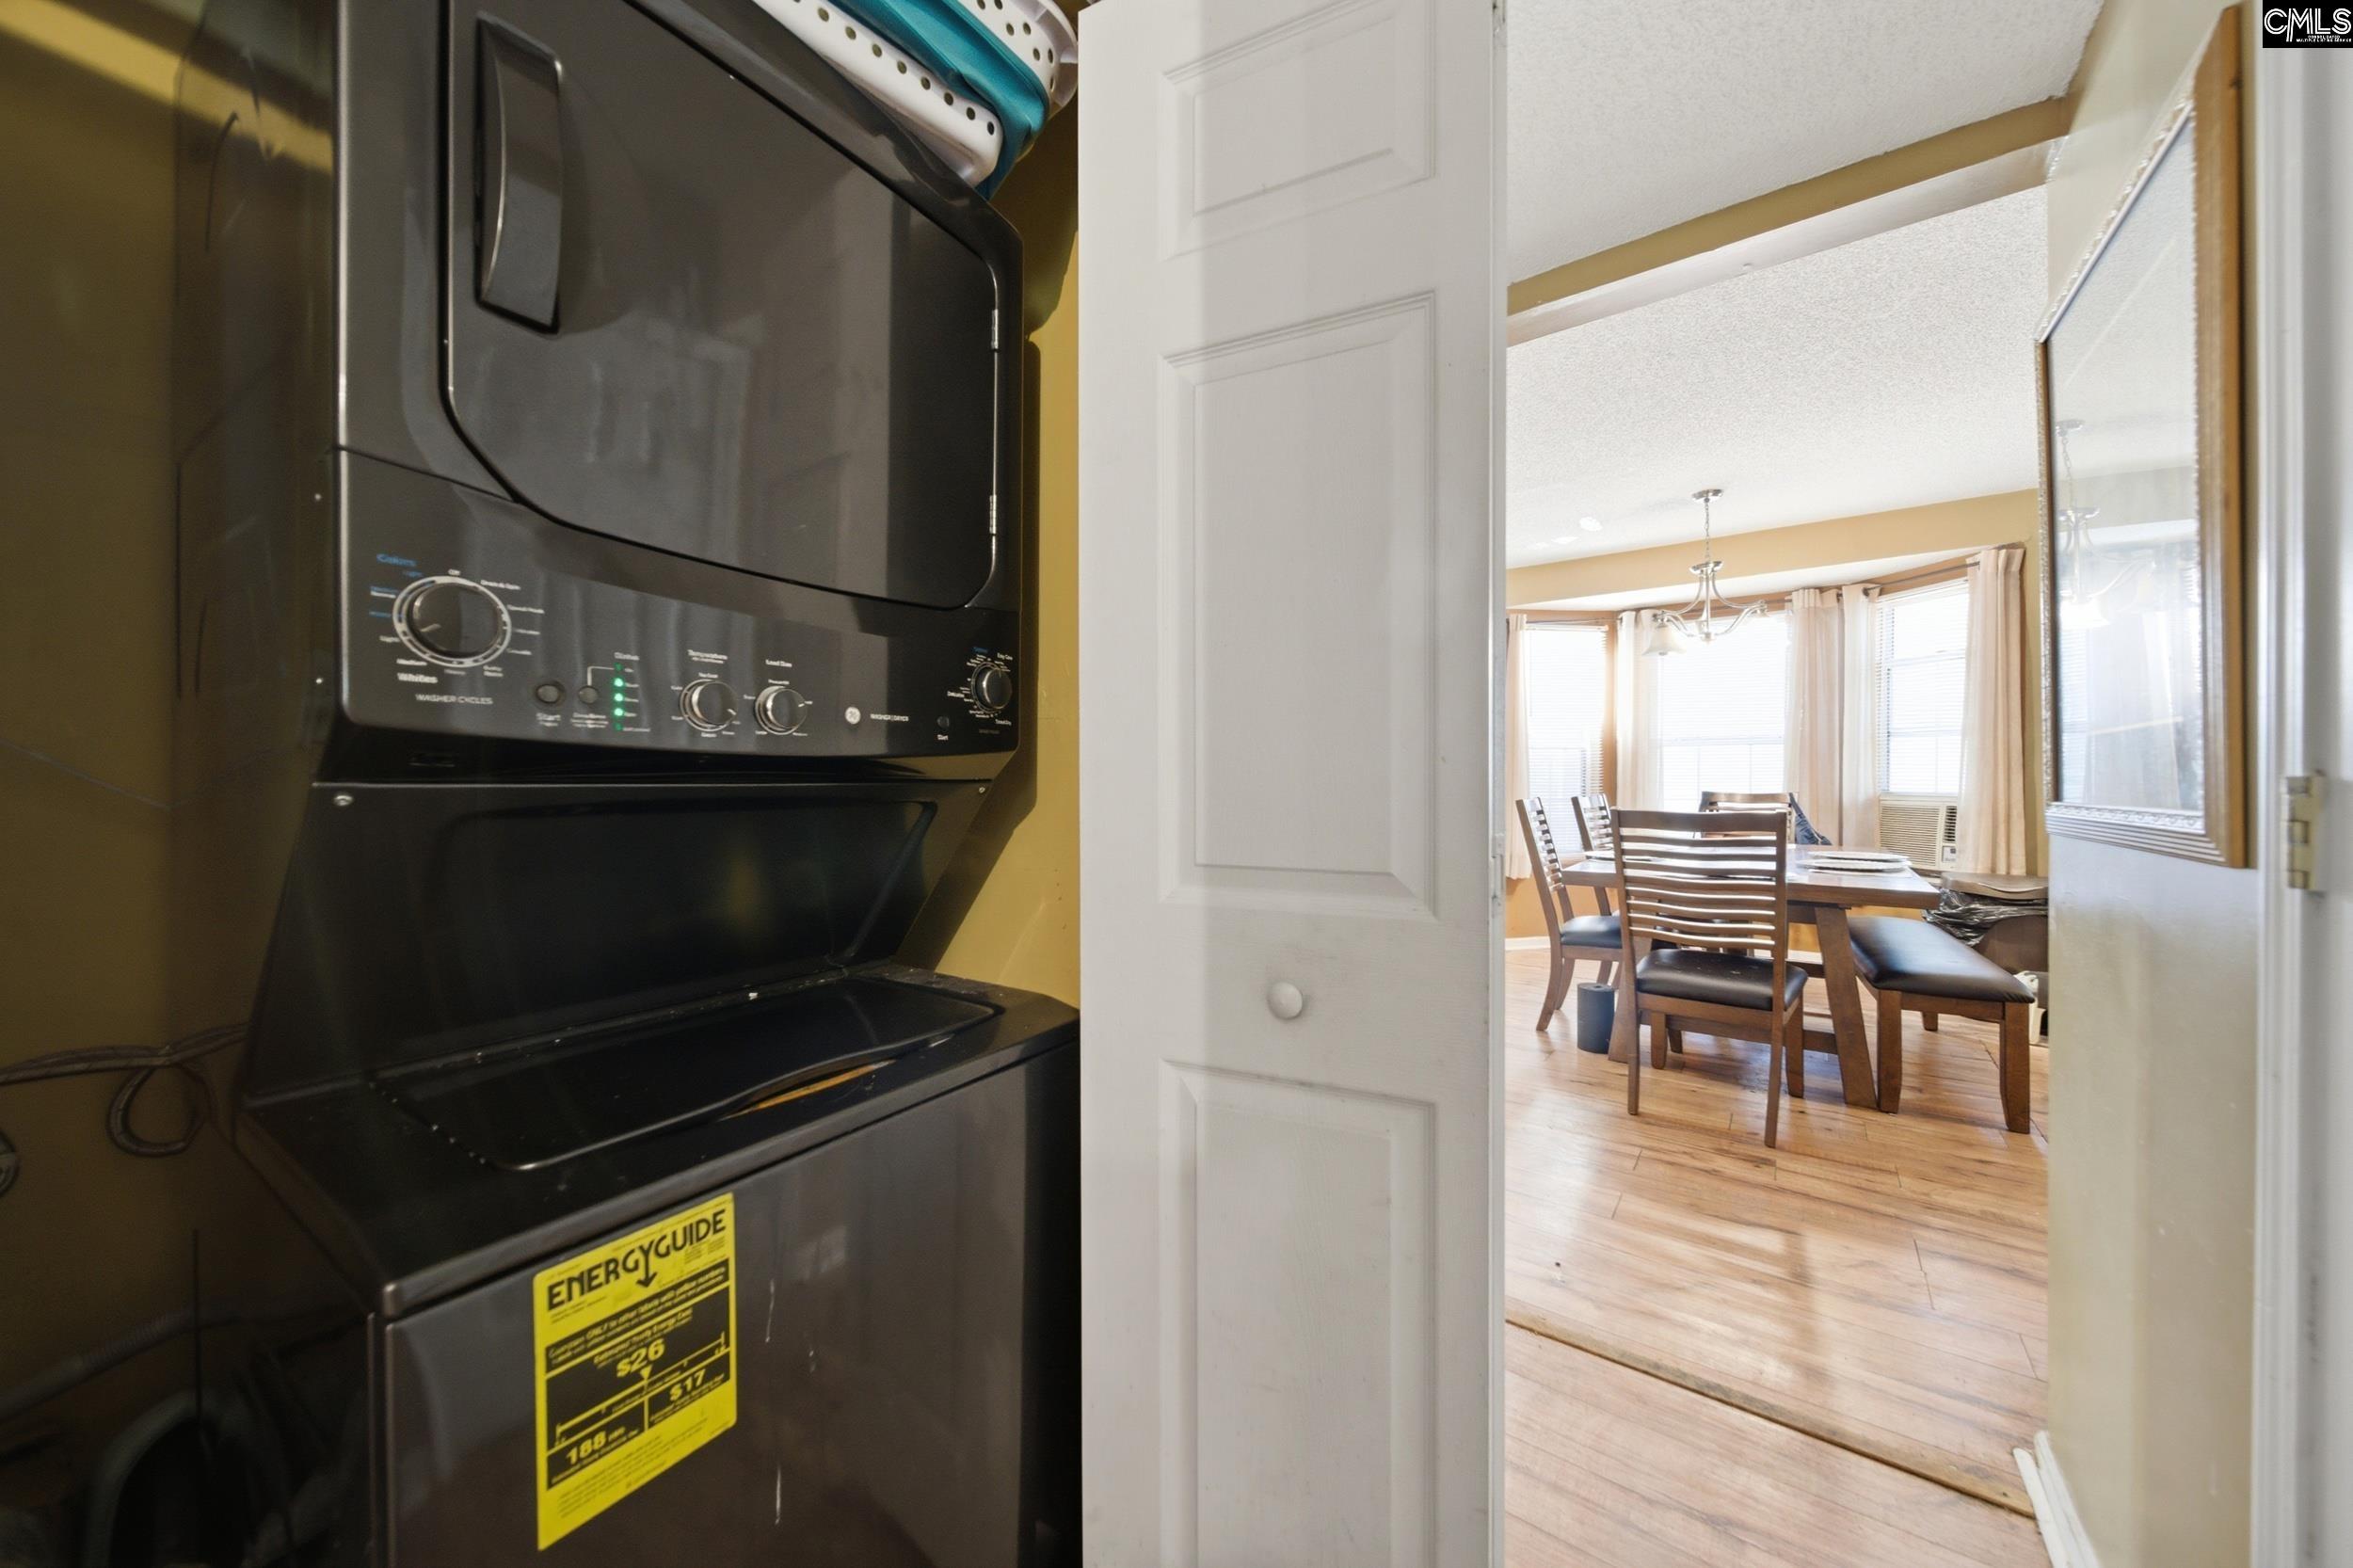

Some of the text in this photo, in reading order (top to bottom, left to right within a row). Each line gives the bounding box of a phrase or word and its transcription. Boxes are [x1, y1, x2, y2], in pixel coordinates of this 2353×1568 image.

[415, 693, 493, 705] WASHER CYCLES
[547, 1208, 727, 1310] ENERGYGUIDE
[616, 1338, 664, 1378] $26
[669, 1368, 706, 1401] $17
[566, 1431, 606, 1464] 188
